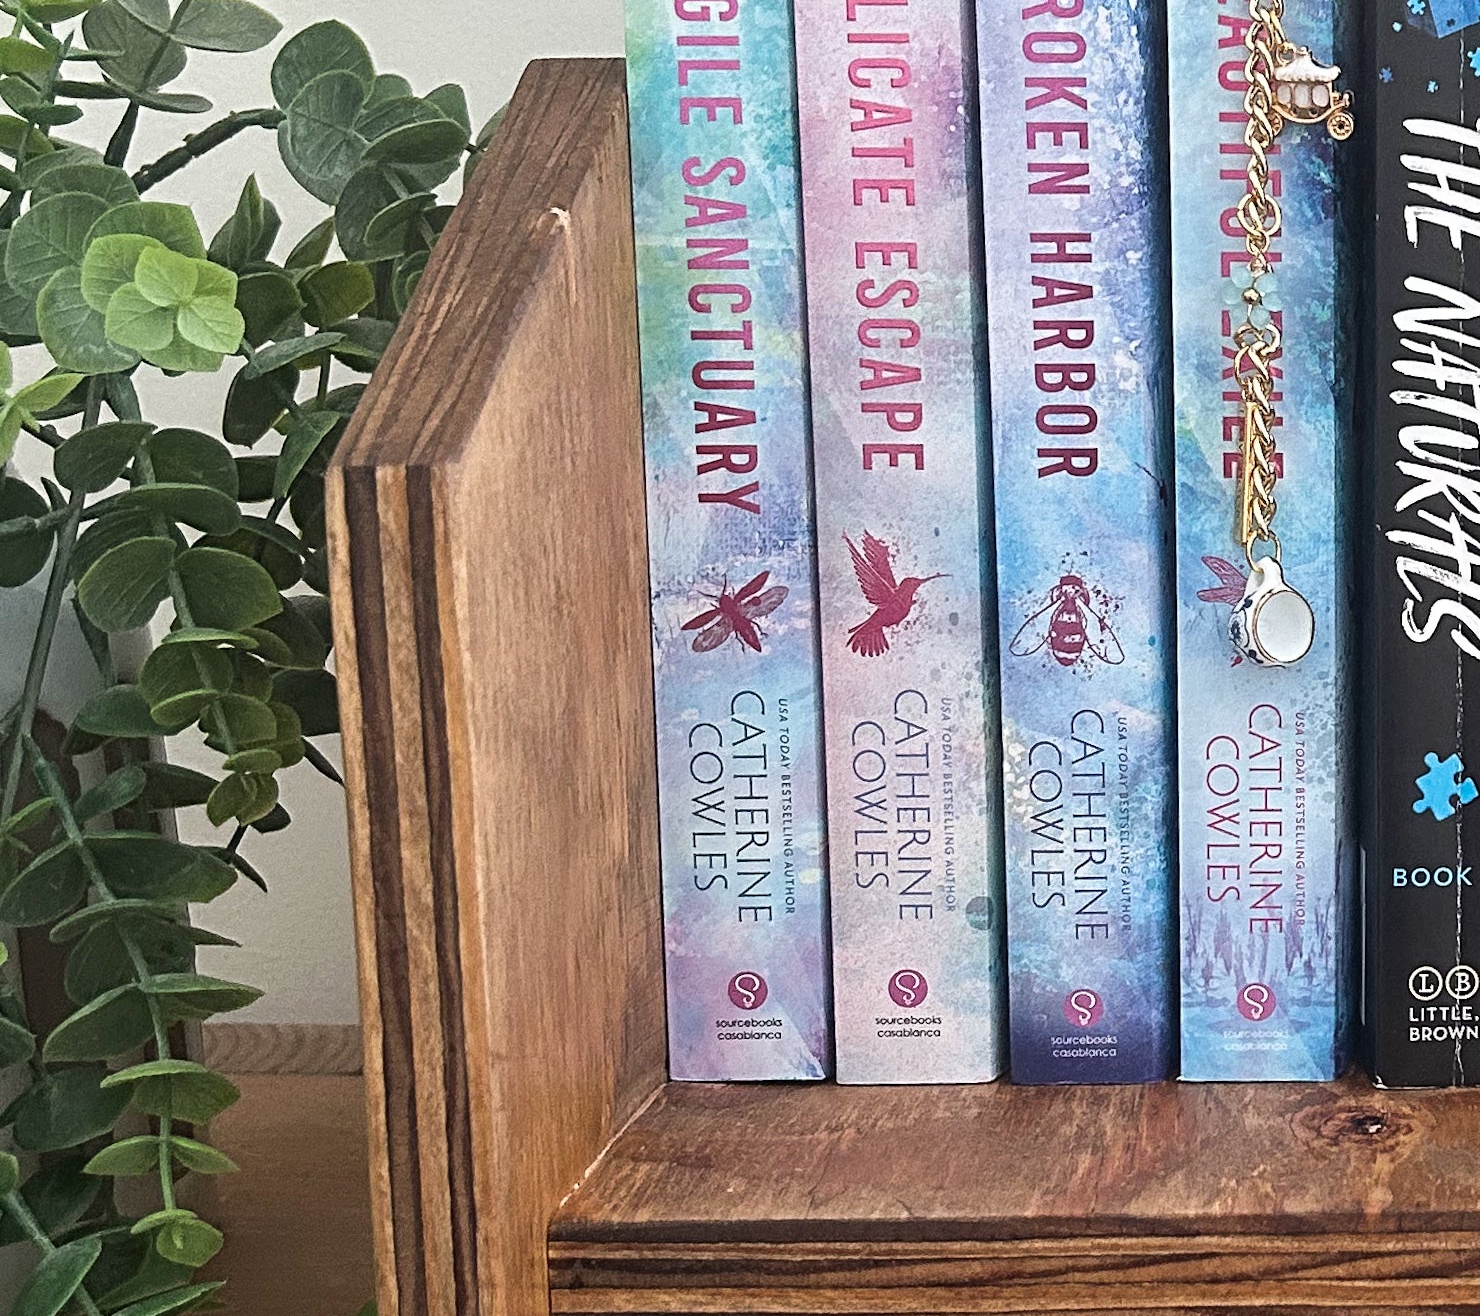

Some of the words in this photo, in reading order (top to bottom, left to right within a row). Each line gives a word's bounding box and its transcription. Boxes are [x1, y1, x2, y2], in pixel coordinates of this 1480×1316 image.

[681, 157, 761, 515] SANCTUARY
[855, 240, 925, 472] ESCAPE
[1028, 232, 1099, 480] HARBOR
[778, 698, 789, 724] USA
[941, 697, 951, 722] USA
[1117, 716, 1128, 741] USA
[1295, 711, 1305, 736] USA
[779, 727, 790, 769] TODAY
[942, 725, 953, 768] TODAY
[1118, 744, 1129, 789] TODAY
[1294, 740, 1305, 785] TODAY
[689, 722, 729, 892] COWLES
[730, 690, 773, 923] CATHERINE
[780, 771, 794, 857] BESTSELLING
[851, 721, 890, 889] COWLES
[893, 689, 934, 921] CATHERINE
[943, 770, 955, 855] BESTSELLING
[1028, 740, 1066, 910] COWLES
[1070, 709, 1109, 940] CATHERINE
[1205, 735, 1241, 903] COWLES
[1248, 703, 1284, 935] CATHERINE
[1294, 787, 1306, 870] BESTSELLING
[1119, 791, 1131, 875] BESTSELLING
[784, 860, 796, 915] AUTHOR
[945, 859, 957, 913] AUTHOR
[1294, 873, 1306, 927] AUTHOR
[1392, 867, 1474, 888] BOOK
[1120, 879, 1132, 932] AUTHOR
[715, 1017, 783, 1029] sourcebooks
[716, 1030, 782, 1042] casablanca
[874, 1015, 942, 1026] sourcebooks
[876, 1028, 941, 1039] casablanca
[1050, 1034, 1119, 1046] sourcebooks
[1408, 1007, 1480, 1022] LITTLE,
[1408, 1026, 1479, 1042] BROWN
[1052, 1047, 1118, 1058] casablanca
